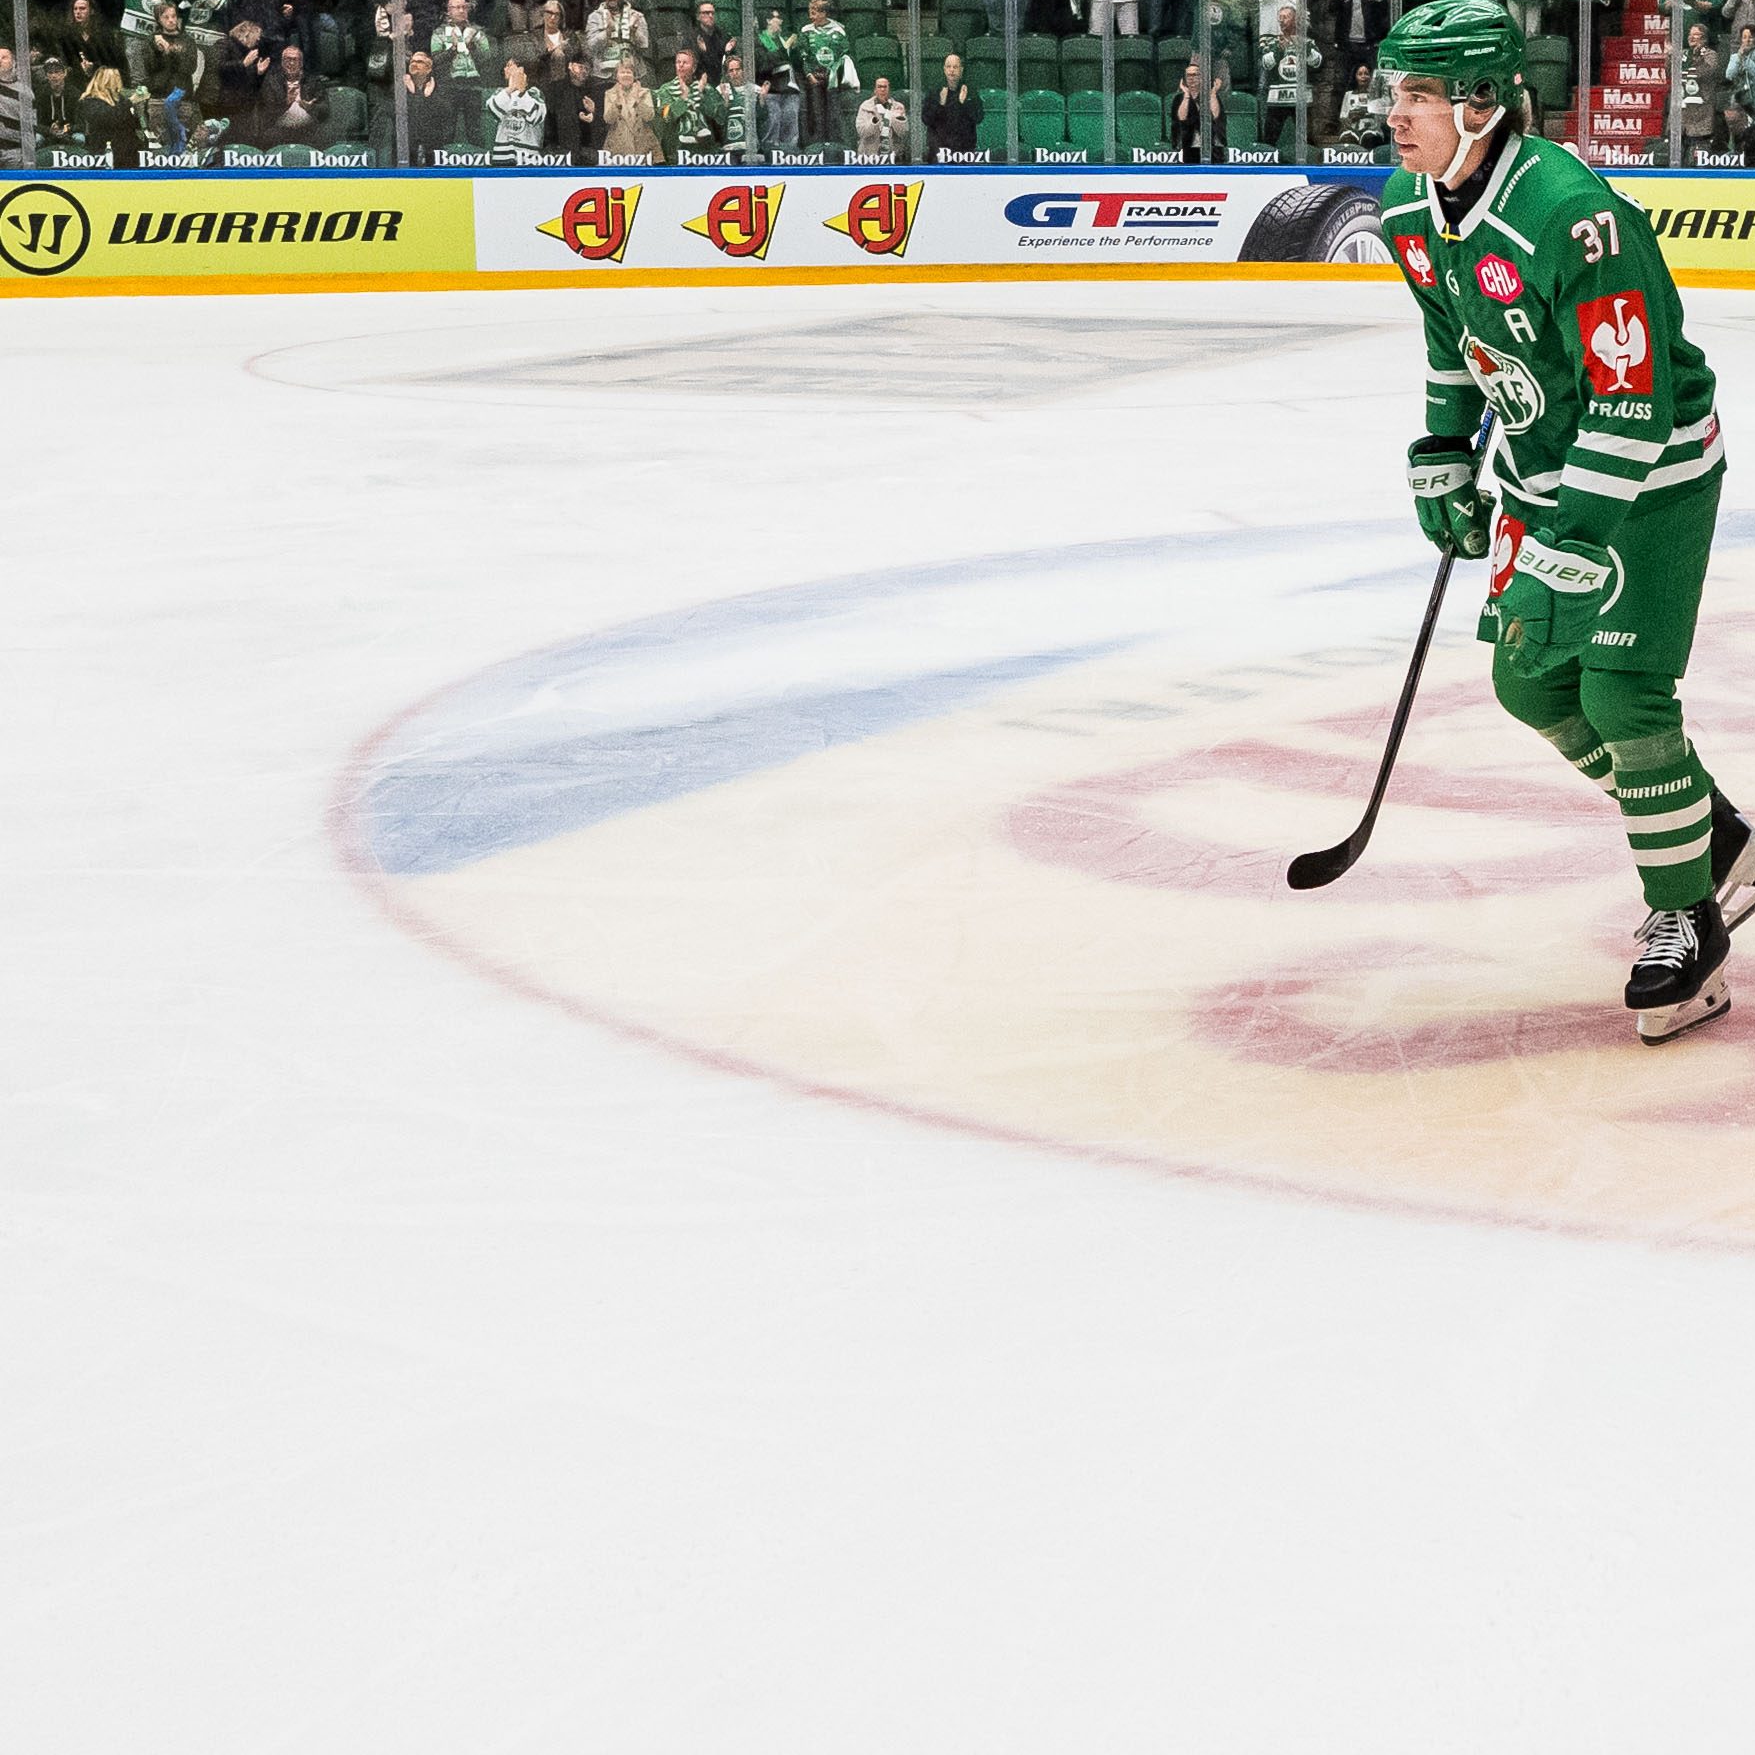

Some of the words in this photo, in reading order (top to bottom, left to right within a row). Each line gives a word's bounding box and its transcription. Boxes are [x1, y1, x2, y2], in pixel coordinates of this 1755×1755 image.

[1603, 88, 1652, 105] MAXI
[1593, 113, 1643, 131] MAXI
[52, 149, 113, 169] Boozt
[138, 149, 200, 169] Boozt
[224, 149, 284, 169] Boozt
[309, 149, 369, 169] Boozt
[433, 149, 492, 169] Boozt
[516, 149, 574, 168] Boozt
[597, 149, 655, 168] Boozt
[677, 149, 733, 168] Boozt
[770, 148, 826, 167] Boozt
[843, 149, 898, 167] Boozt
[938, 147, 993, 166] Boozt
[1035, 147, 1089, 166] Boozt
[1132, 147, 1186, 166] Boozt
[1228, 147, 1281, 166] Boozt
[1323, 147, 1376, 166] Boozt
[1604, 149, 1655, 166] Boozt
[1696, 150, 1747, 167] Boozt
[1496, 152, 1541, 212] WARRIOR
[1125, 205, 1223, 218] RADIAL
[108, 207, 404, 245] WARRIOR
[1018, 234, 1095, 248] Experience
[1099, 235, 1121, 247] the
[1125, 235, 1214, 247] Performance
[1570, 210, 1620, 265] 37
[1480, 261, 1519, 296] CHL
[1503, 307, 1537, 343] A
[1588, 399, 1653, 422] TRAUSS
